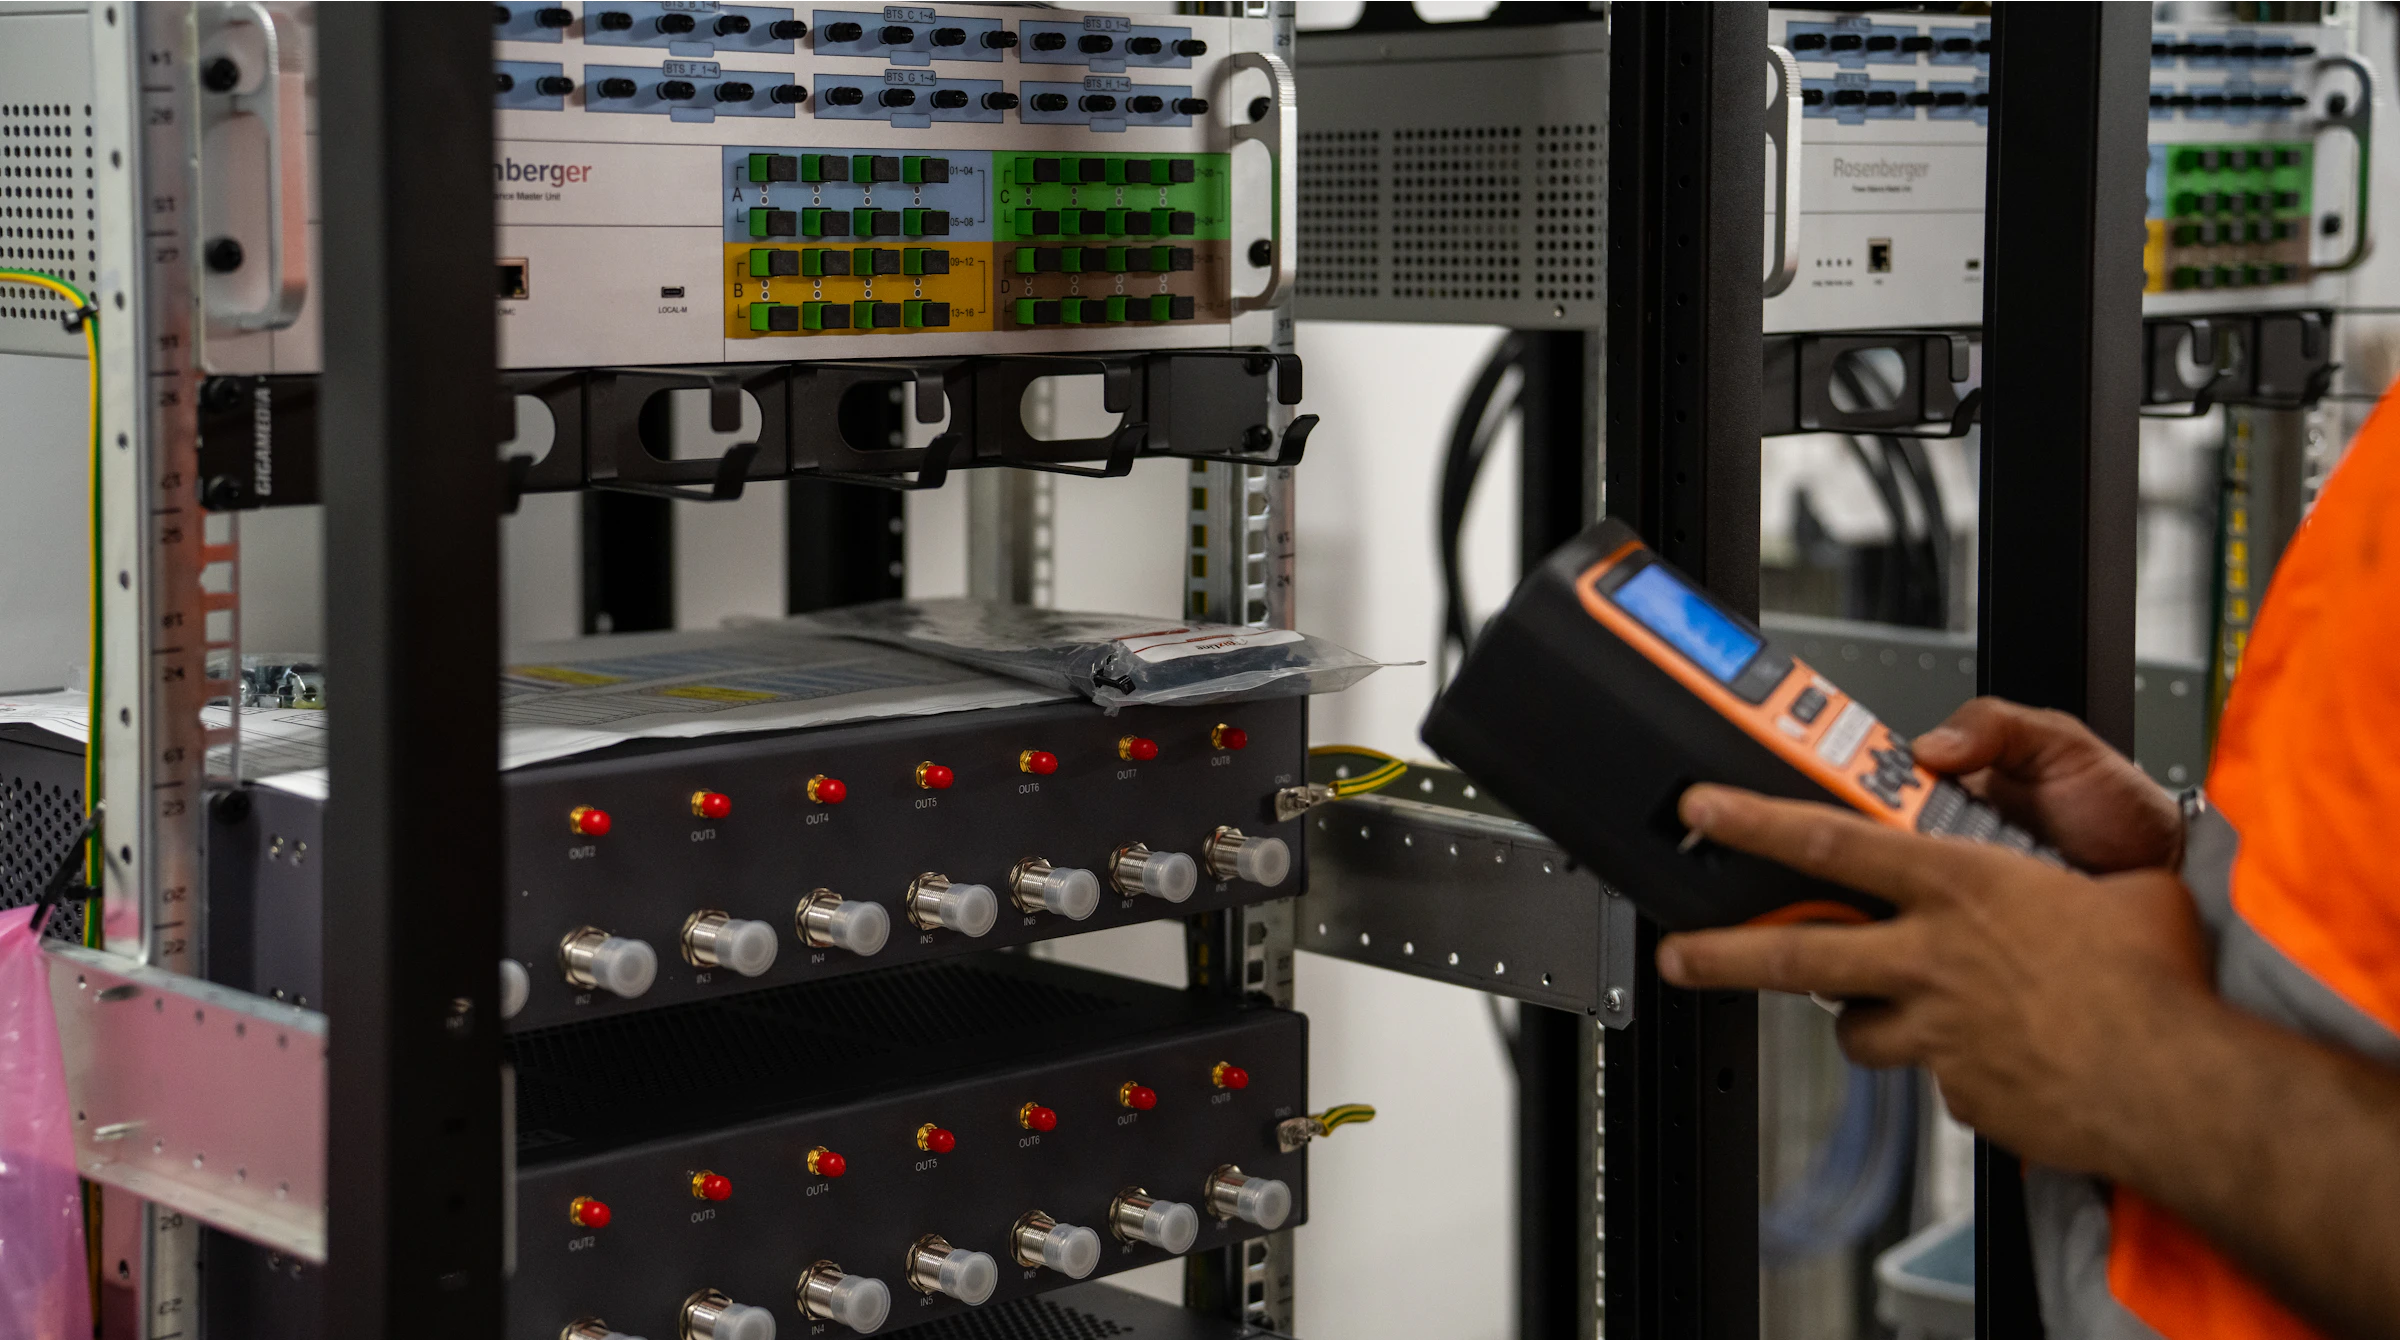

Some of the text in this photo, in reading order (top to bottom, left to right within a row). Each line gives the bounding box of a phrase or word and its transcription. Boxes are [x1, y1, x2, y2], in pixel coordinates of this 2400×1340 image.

[732, 187, 743, 202] A
[1000, 190, 1010, 204] C
[734, 284, 744, 298] B
[1001, 280, 1010, 294] D
[1211, 755, 1231, 767] OUT8
[1117, 769, 1137, 781] OUT7
[1019, 782, 1040, 795] OUT6
[915, 797, 937, 810] OUT5
[806, 813, 830, 826] OUT4
[691, 829, 716, 843] OUT3
[569, 846, 596, 861] OUT2
[1121, 899, 1134, 910] IN7
[1023, 916, 1036, 927] IN6
[920, 934, 934, 945] IN5
[811, 953, 825, 965] IN4
[1117, 1113, 1137, 1126] OUT7
[1019, 1136, 1040, 1149] OUT6
[915, 1158, 938, 1172] OUT5
[806, 1183, 830, 1197] OUT4
[691, 1209, 716, 1224] OUT3
[569, 1236, 596, 1251] OUT2
[1023, 1269, 1037, 1280] IN6
[920, 1296, 934, 1307] IN5
[811, 1324, 825, 1336] IN4
